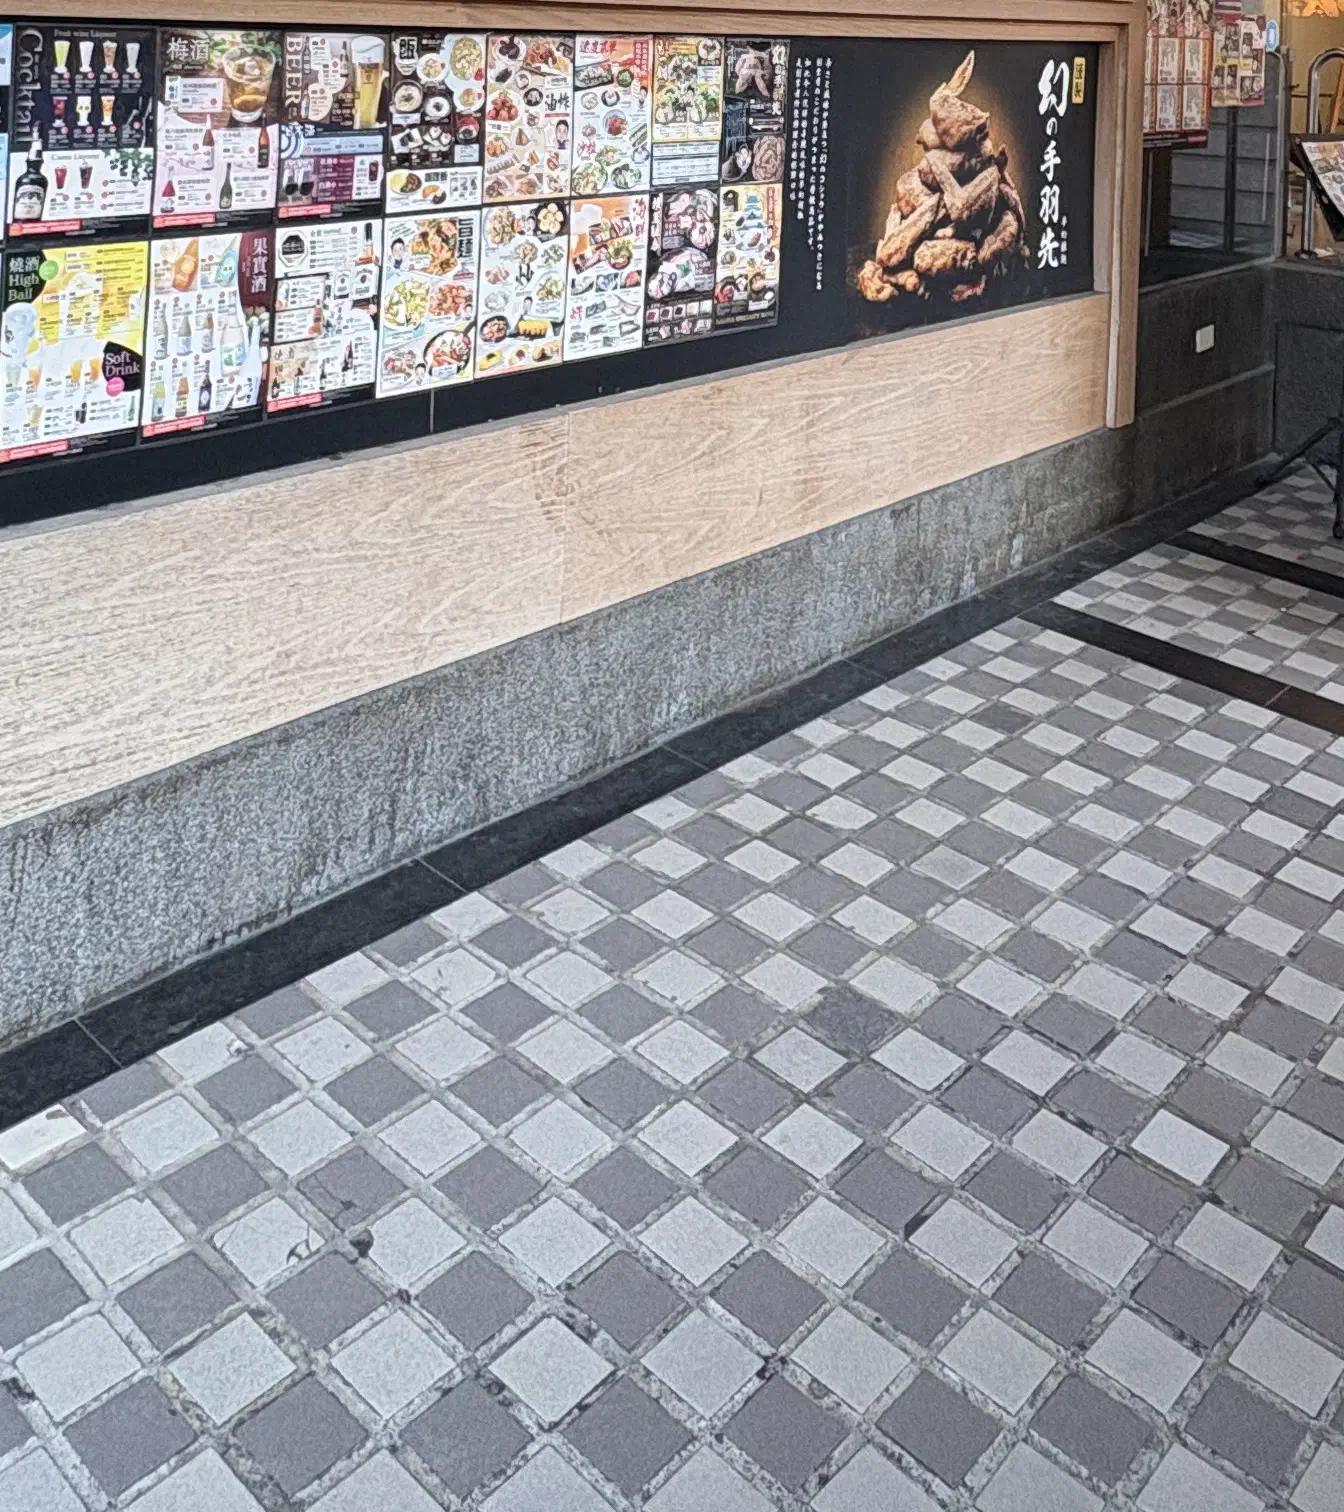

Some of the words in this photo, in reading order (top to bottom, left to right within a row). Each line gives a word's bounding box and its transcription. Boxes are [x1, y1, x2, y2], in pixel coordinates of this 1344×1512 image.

[285, 36, 303, 107] BEER
[16, 29, 43, 141] Cocktail
[1037, 59, 1069, 269] 幻の手羽先
[9, 273, 40, 287] High
[8, 288, 32, 301] Ball
[105, 351, 131, 365] Soft
[105, 363, 141, 377] Drink
